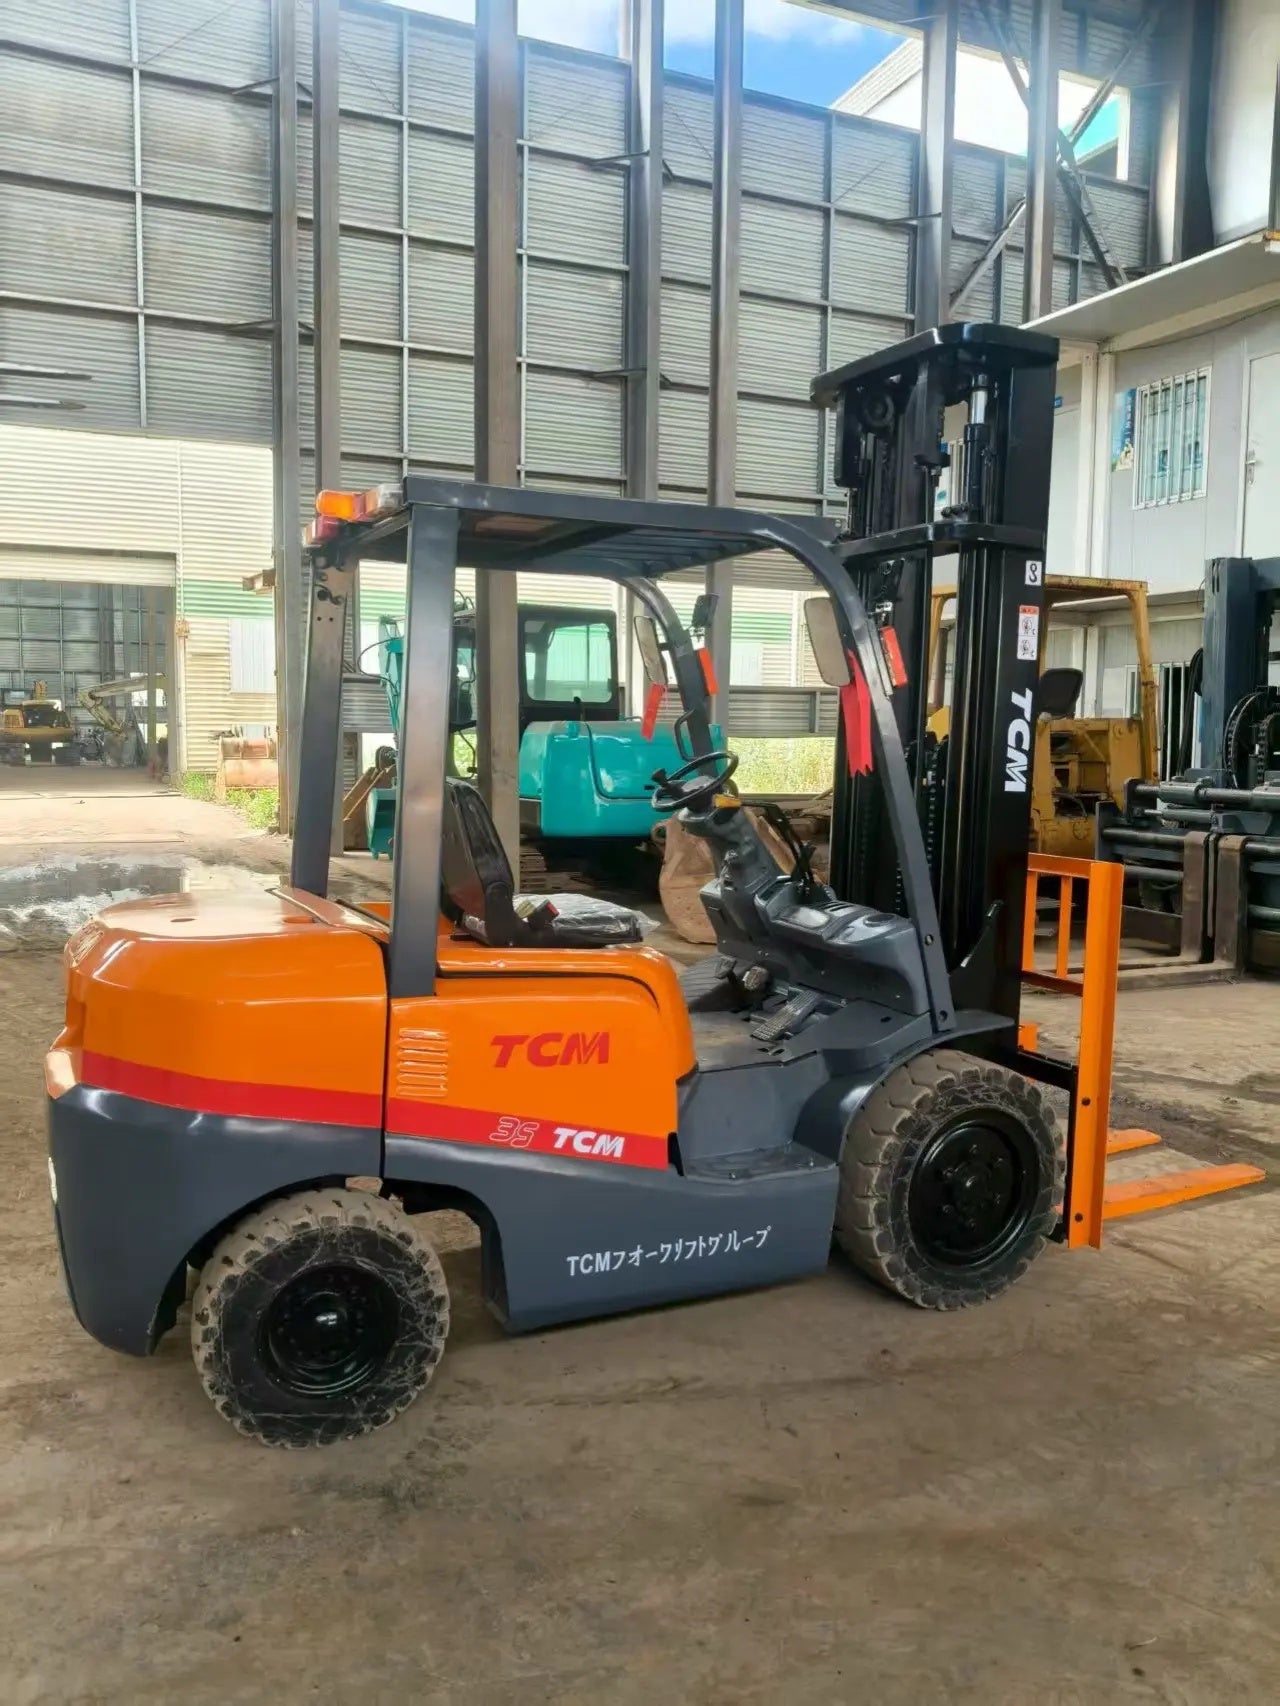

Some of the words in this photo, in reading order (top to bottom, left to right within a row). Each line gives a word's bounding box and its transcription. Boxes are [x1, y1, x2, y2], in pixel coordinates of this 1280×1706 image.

[1004, 688, 1033, 792] TCM
[490, 1032, 609, 1068] TCM
[553, 1127, 625, 1158] TCM
